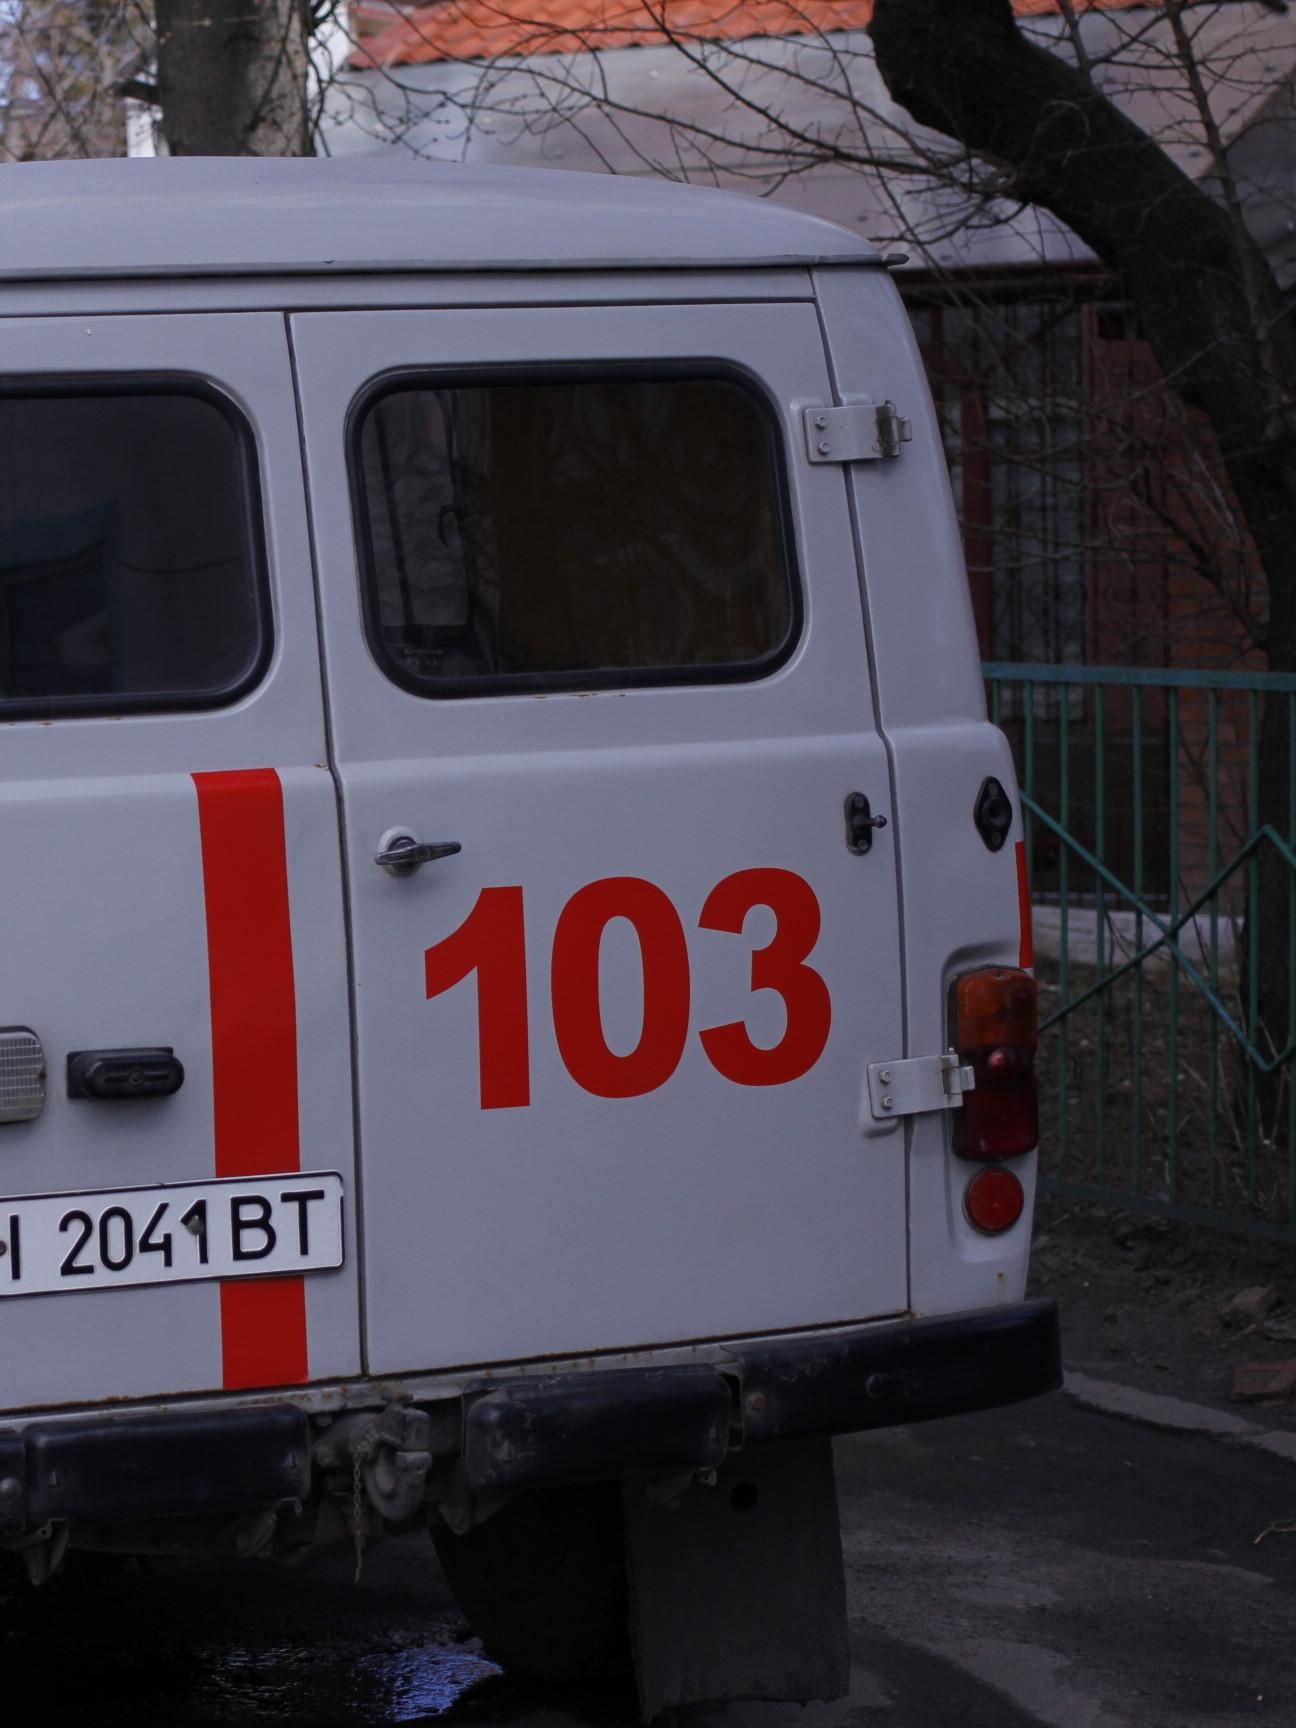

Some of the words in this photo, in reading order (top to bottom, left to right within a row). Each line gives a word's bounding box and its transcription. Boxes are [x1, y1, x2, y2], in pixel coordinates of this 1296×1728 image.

[424, 867, 832, 1110] 103
[58, 1199, 209, 1277] 2041
[230, 1188, 326, 1262] BT
